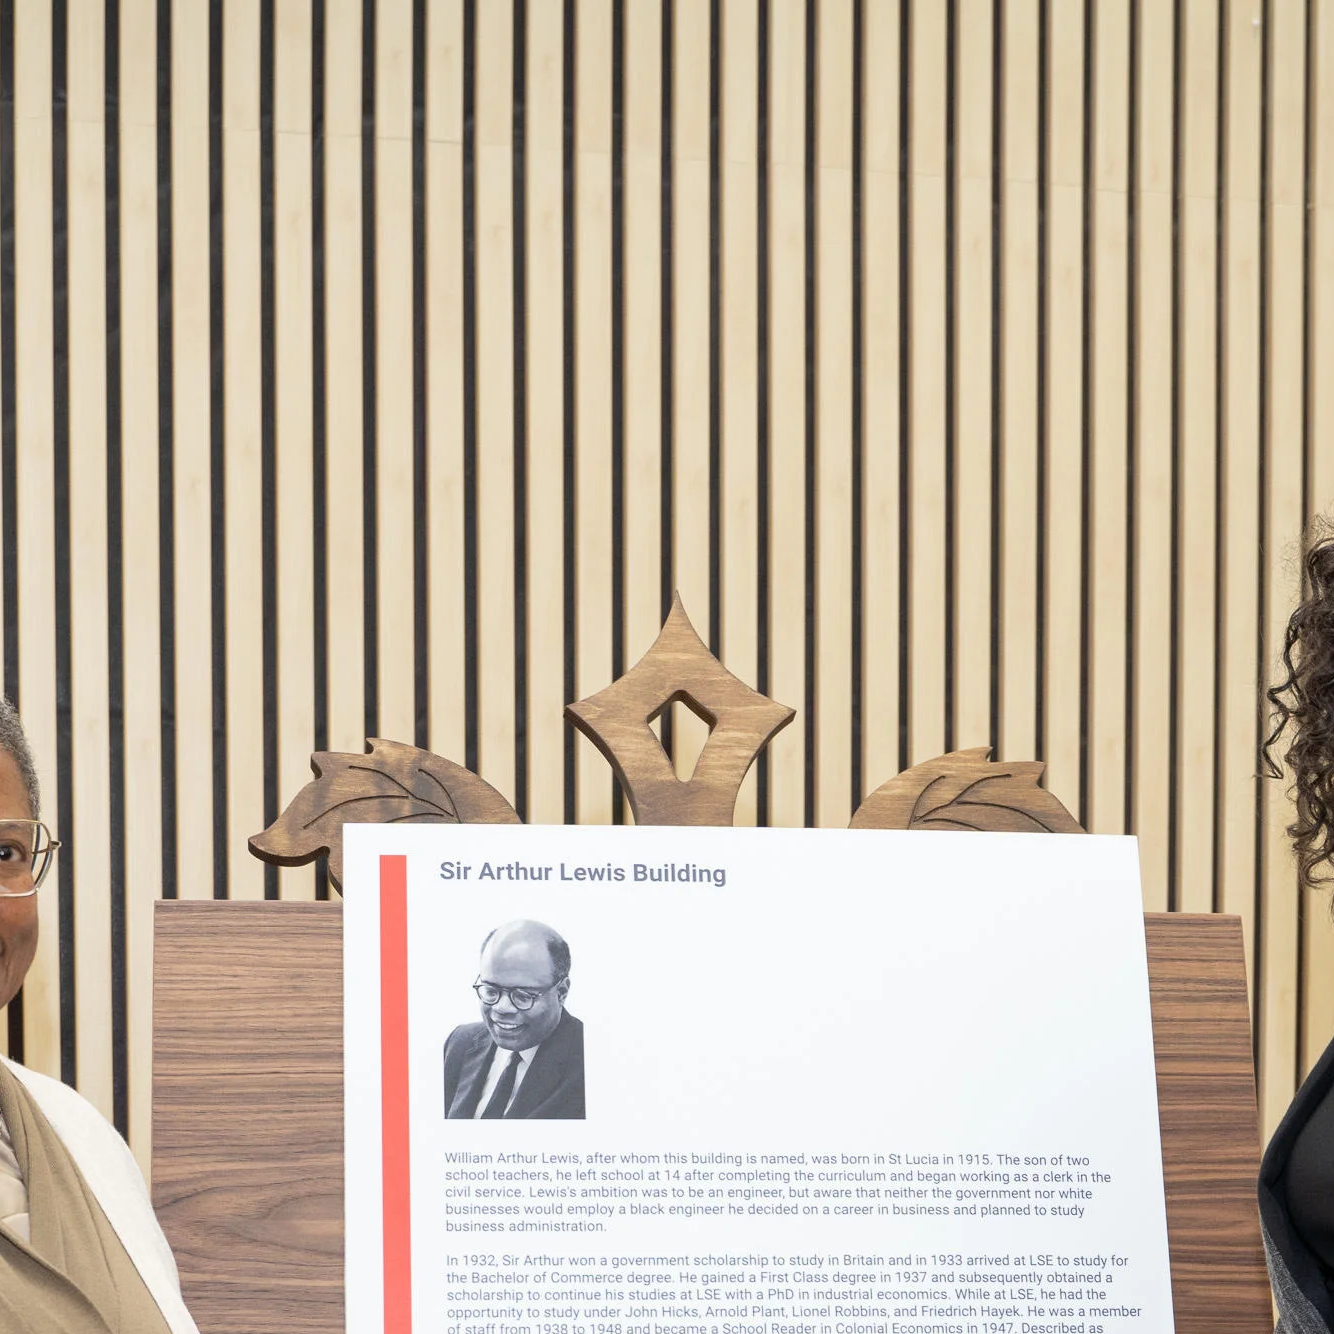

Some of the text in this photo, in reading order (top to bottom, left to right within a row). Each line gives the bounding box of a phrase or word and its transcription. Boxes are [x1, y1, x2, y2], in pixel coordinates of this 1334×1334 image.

[440, 861, 725, 887] Sir Arthur Lewis Building
[445, 1152, 1089, 1166] William Arthur Lewis, after whom this building is named, was born in St Lucia in 1915. The son of two
[445, 1219, 606, 1232] business administration.
[447, 1305, 1142, 1320] opportunity to study under John Hicks, Arnold Plant, Lionel Robbins, and Friedrich Hayek. He was a member
